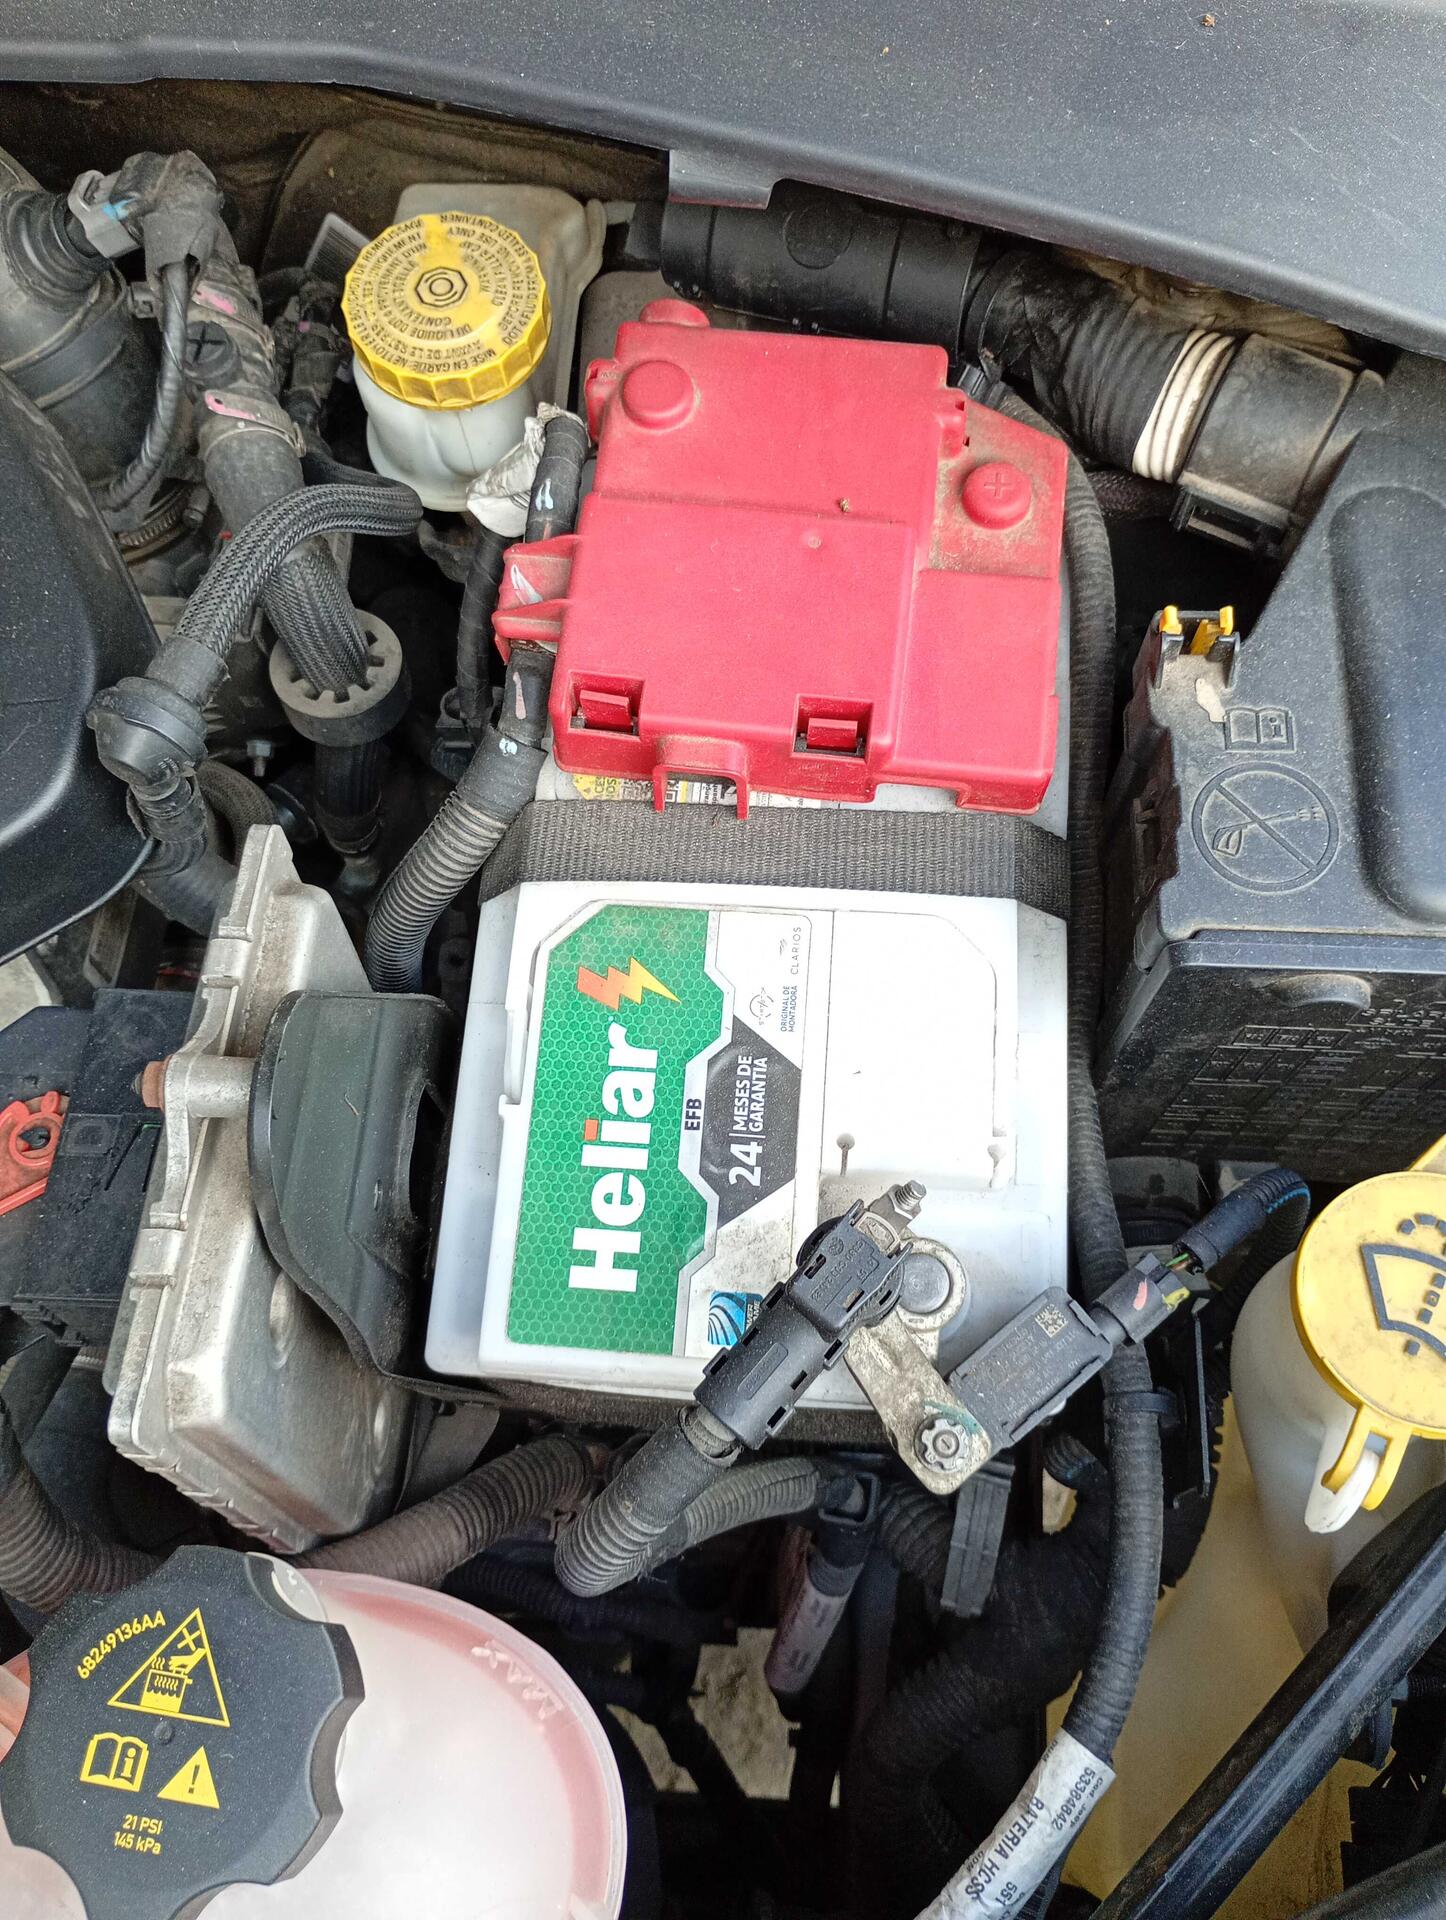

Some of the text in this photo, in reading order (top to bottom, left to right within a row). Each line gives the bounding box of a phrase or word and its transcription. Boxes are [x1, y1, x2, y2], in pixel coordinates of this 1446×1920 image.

[439, 209, 500, 236] CONTAINER
[447, 224, 476, 240] ONLY
[360, 216, 422, 262] REMPLISSAGE
[476, 231, 498, 248] USE
[496, 226, 529, 258] SEALED
[353, 262, 366, 275] DE
[496, 294, 522, 331] BEFORE
[520, 293, 537, 320] FLUID
[387, 315, 409, 334] DOT
[410, 324, 455, 343] LIQUIDE
[455, 323, 473, 336] DU
[500, 325, 524, 347] DOT
[517, 319, 527, 328] 4
[359, 331, 408, 368] NETTOYER
[408, 346, 423, 357] LE
[425, 348, 441, 359] DE
[444, 339, 483, 357] AVANT
[470, 348, 497, 365] MISE
[453, 359, 468, 370] EN
[790, 927, 801, 975] CLARIOS
[780, 986, 790, 1032] ORIGINAL DE
[788, 986, 798, 1032] MONTADORA
[748, 1057, 768, 1133] GARANTIA
[684, 1098, 702, 1131] EFB
[729, 1055, 762, 1187] 24 MESES DE
[568, 1022, 658, 1292] Heliar
[77, 1610, 166, 1679] 68249136AA
[1052, 1767, 1096, 1831] 53384842
[123, 1814, 163, 1835] 21 PSI
[114, 1832, 162, 1855] 145 kPa
[965, 1857, 1000, 1901] HCSS
[994, 1881, 1018, 1907] 551
